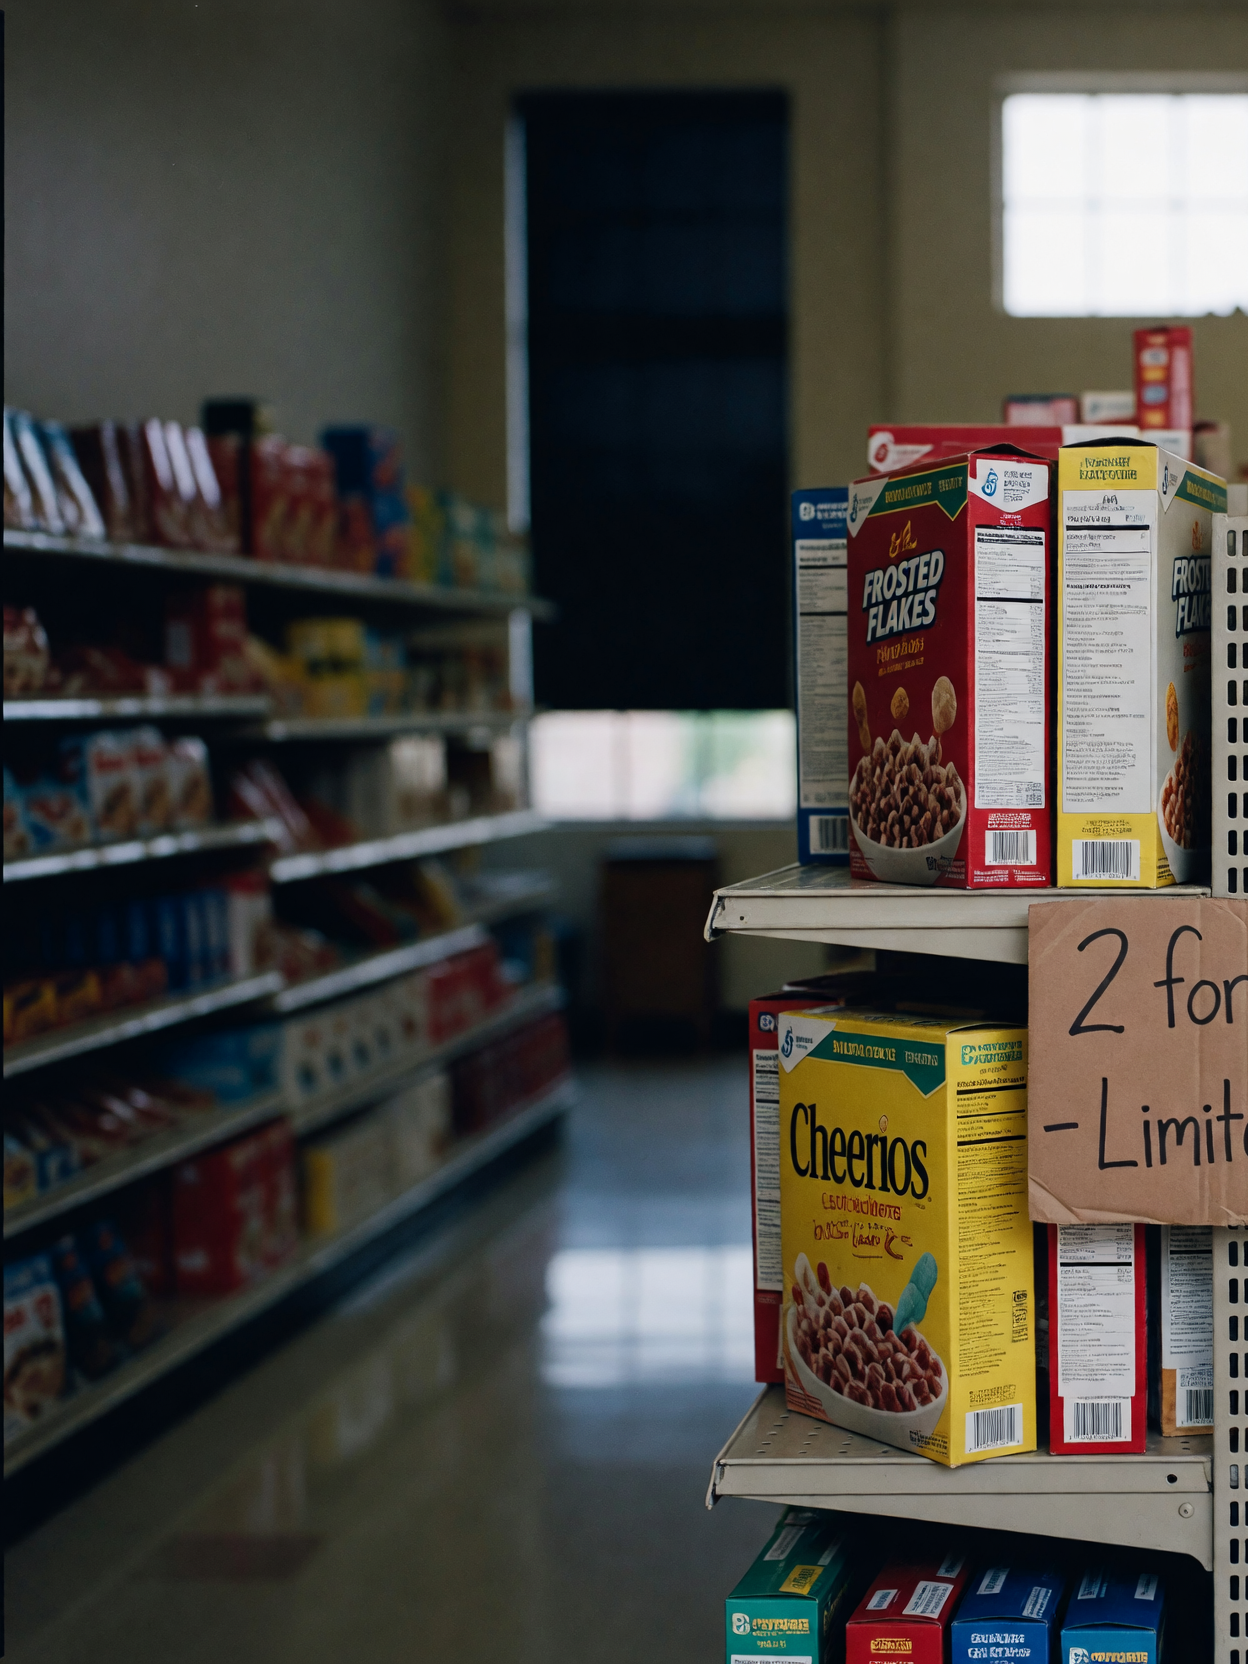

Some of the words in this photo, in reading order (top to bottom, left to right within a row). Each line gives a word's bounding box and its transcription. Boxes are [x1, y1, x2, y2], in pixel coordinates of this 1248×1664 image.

[862, 550, 945, 609] FROSTED
[1173, 558, 1211, 596] FROST
[866, 588, 937, 642] FLAKES
[1068, 927, 1129, 1036] 2
[790, 1102, 930, 1200] Cheerios
